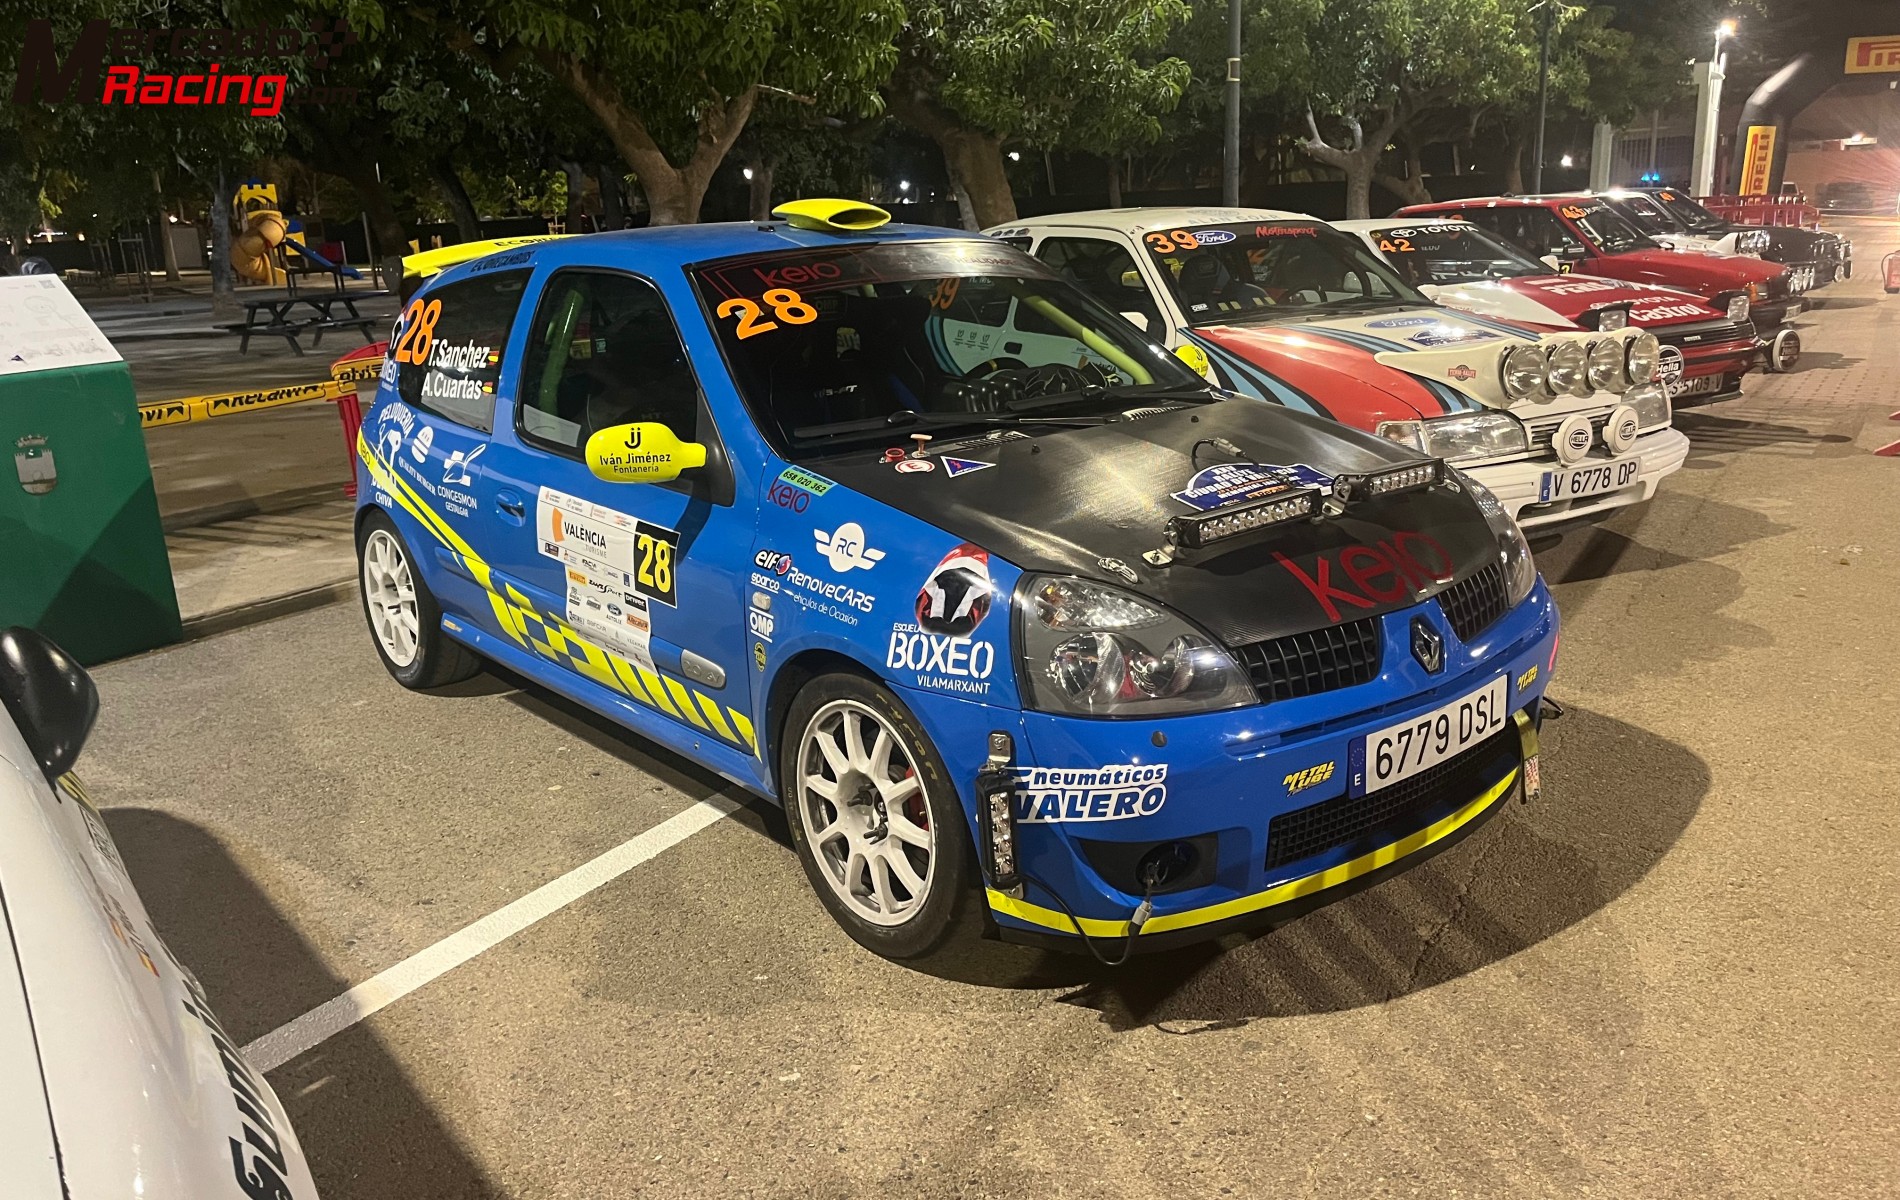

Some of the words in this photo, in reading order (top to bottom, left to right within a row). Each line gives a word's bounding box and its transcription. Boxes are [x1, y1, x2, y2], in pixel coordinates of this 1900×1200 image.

[1196, 232, 1228, 243] Ford
[1417, 225, 1478, 234] TOYOTA
[1147, 230, 1198, 253] 39
[1380, 239, 1415, 252] 42
[717, 288, 818, 340] 28
[1629, 304, 1711, 322] Castrol
[395, 299, 442, 366] 28
[428, 339, 490, 368] T.Sanchez
[421, 372, 482, 400] A.Cuartas
[378, 402, 416, 439] PELUQUERÍA
[600, 453, 622, 465] Iván
[626, 452, 671, 464] Jiménez
[614, 464, 659, 474] Fontanería
[783, 471, 795, 480] 658
[796, 476, 811, 487] 020
[810, 482, 826, 493] 362
[1213, 468, 1255, 483] RALLYE
[1553, 474, 1564, 497] V
[1571, 467, 1611, 494] 6778
[1618, 462, 1637, 485] DP
[438, 485, 477, 509] CONGESMON
[1185, 481, 1232, 499] CIUDAD
[1232, 476, 1246, 487] DE
[375, 491, 392, 508] CHIVA
[445, 502, 469, 517] GESTALGAR
[564, 521, 607, 549] VALÈNCIA
[584, 545, 607, 559] TURISME
[836, 538, 857, 557] RC
[638, 533, 671, 593] 28
[755, 550, 780, 569] elf
[751, 572, 780, 591] sparco
[787, 567, 875, 613] RenoveCARS
[750, 612, 773, 637] OMP
[818, 601, 828, 614] de
[828, 605, 858, 626] Ocasión
[886, 632, 994, 679] BOXEO
[917, 674, 991, 694] VILAMARXANT
[1376, 713, 1449, 779] 6779
[1460, 690, 1501, 745] DSL
[1033, 768, 1164, 786] neumáticos
[1282, 761, 1335, 785] METAL
[1288, 770, 1333, 791] LUBE
[1354, 773, 1361, 786] E
[1015, 787, 1163, 819] VALERO
